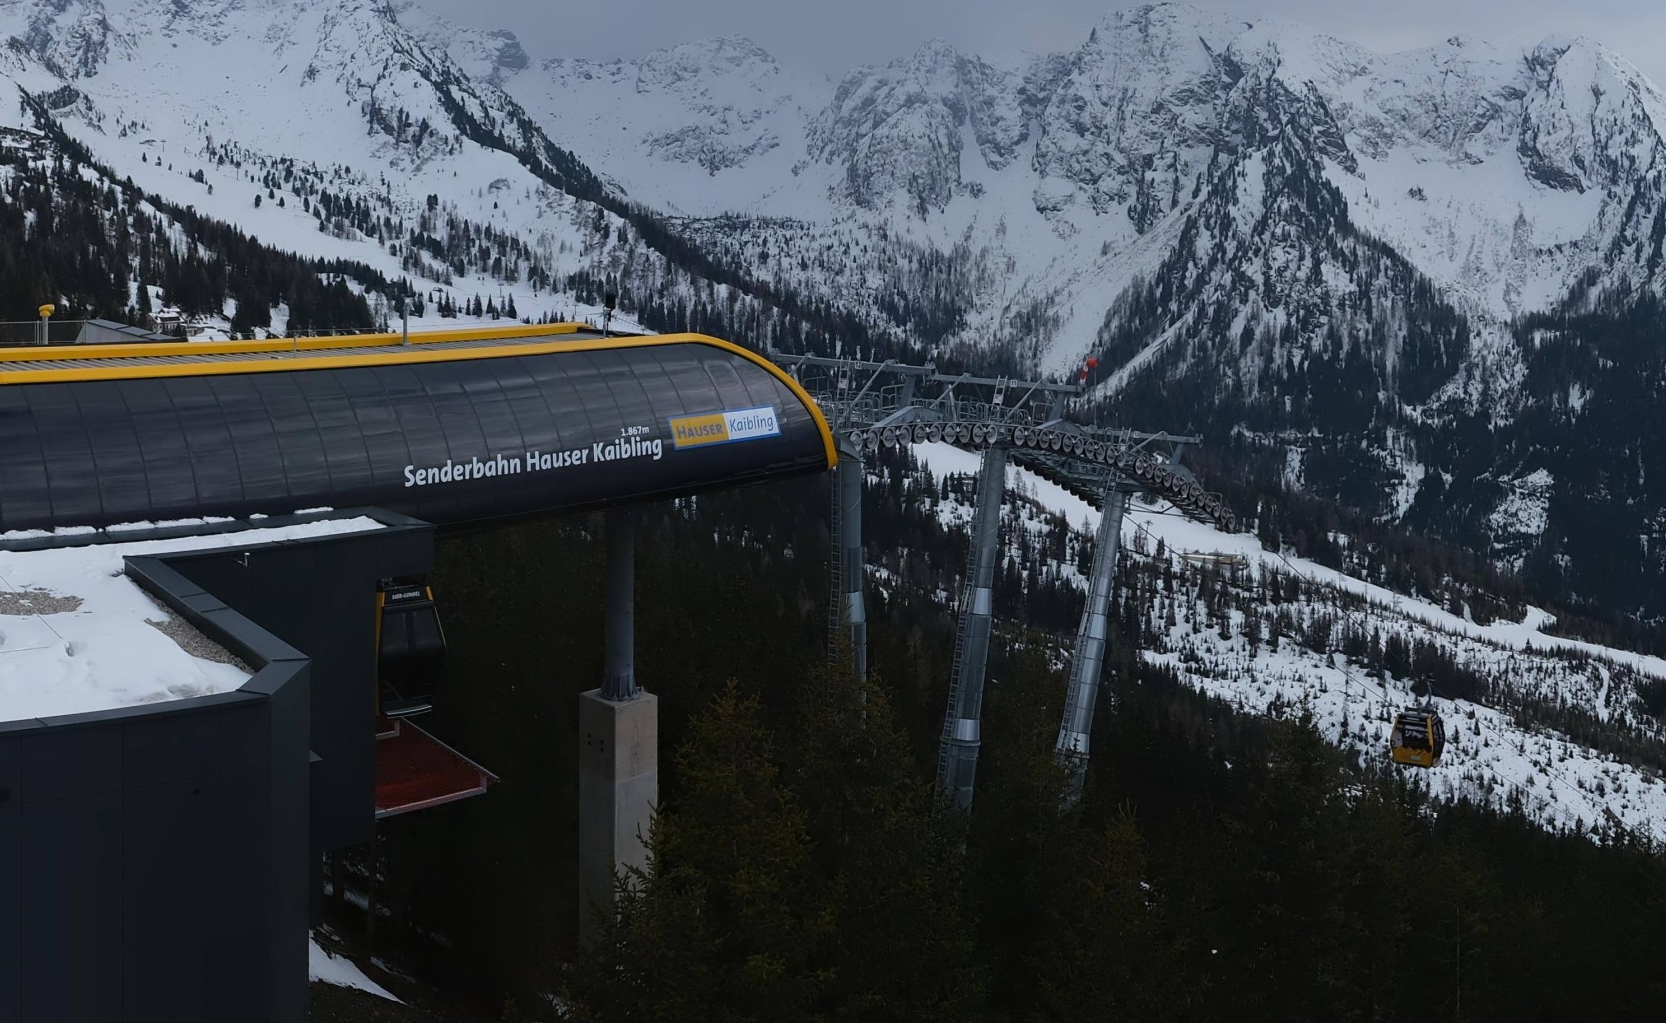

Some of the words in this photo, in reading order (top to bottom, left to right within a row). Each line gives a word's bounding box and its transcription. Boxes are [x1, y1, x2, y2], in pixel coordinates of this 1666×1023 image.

[621, 426, 650, 437] 1.867m
[676, 424, 723, 439] HAUSER
[729, 415, 774, 432] Kaibling
[404, 453, 521, 488] Senderbahn
[526, 448, 589, 472] Hauser
[593, 437, 663, 462] Kaibling
